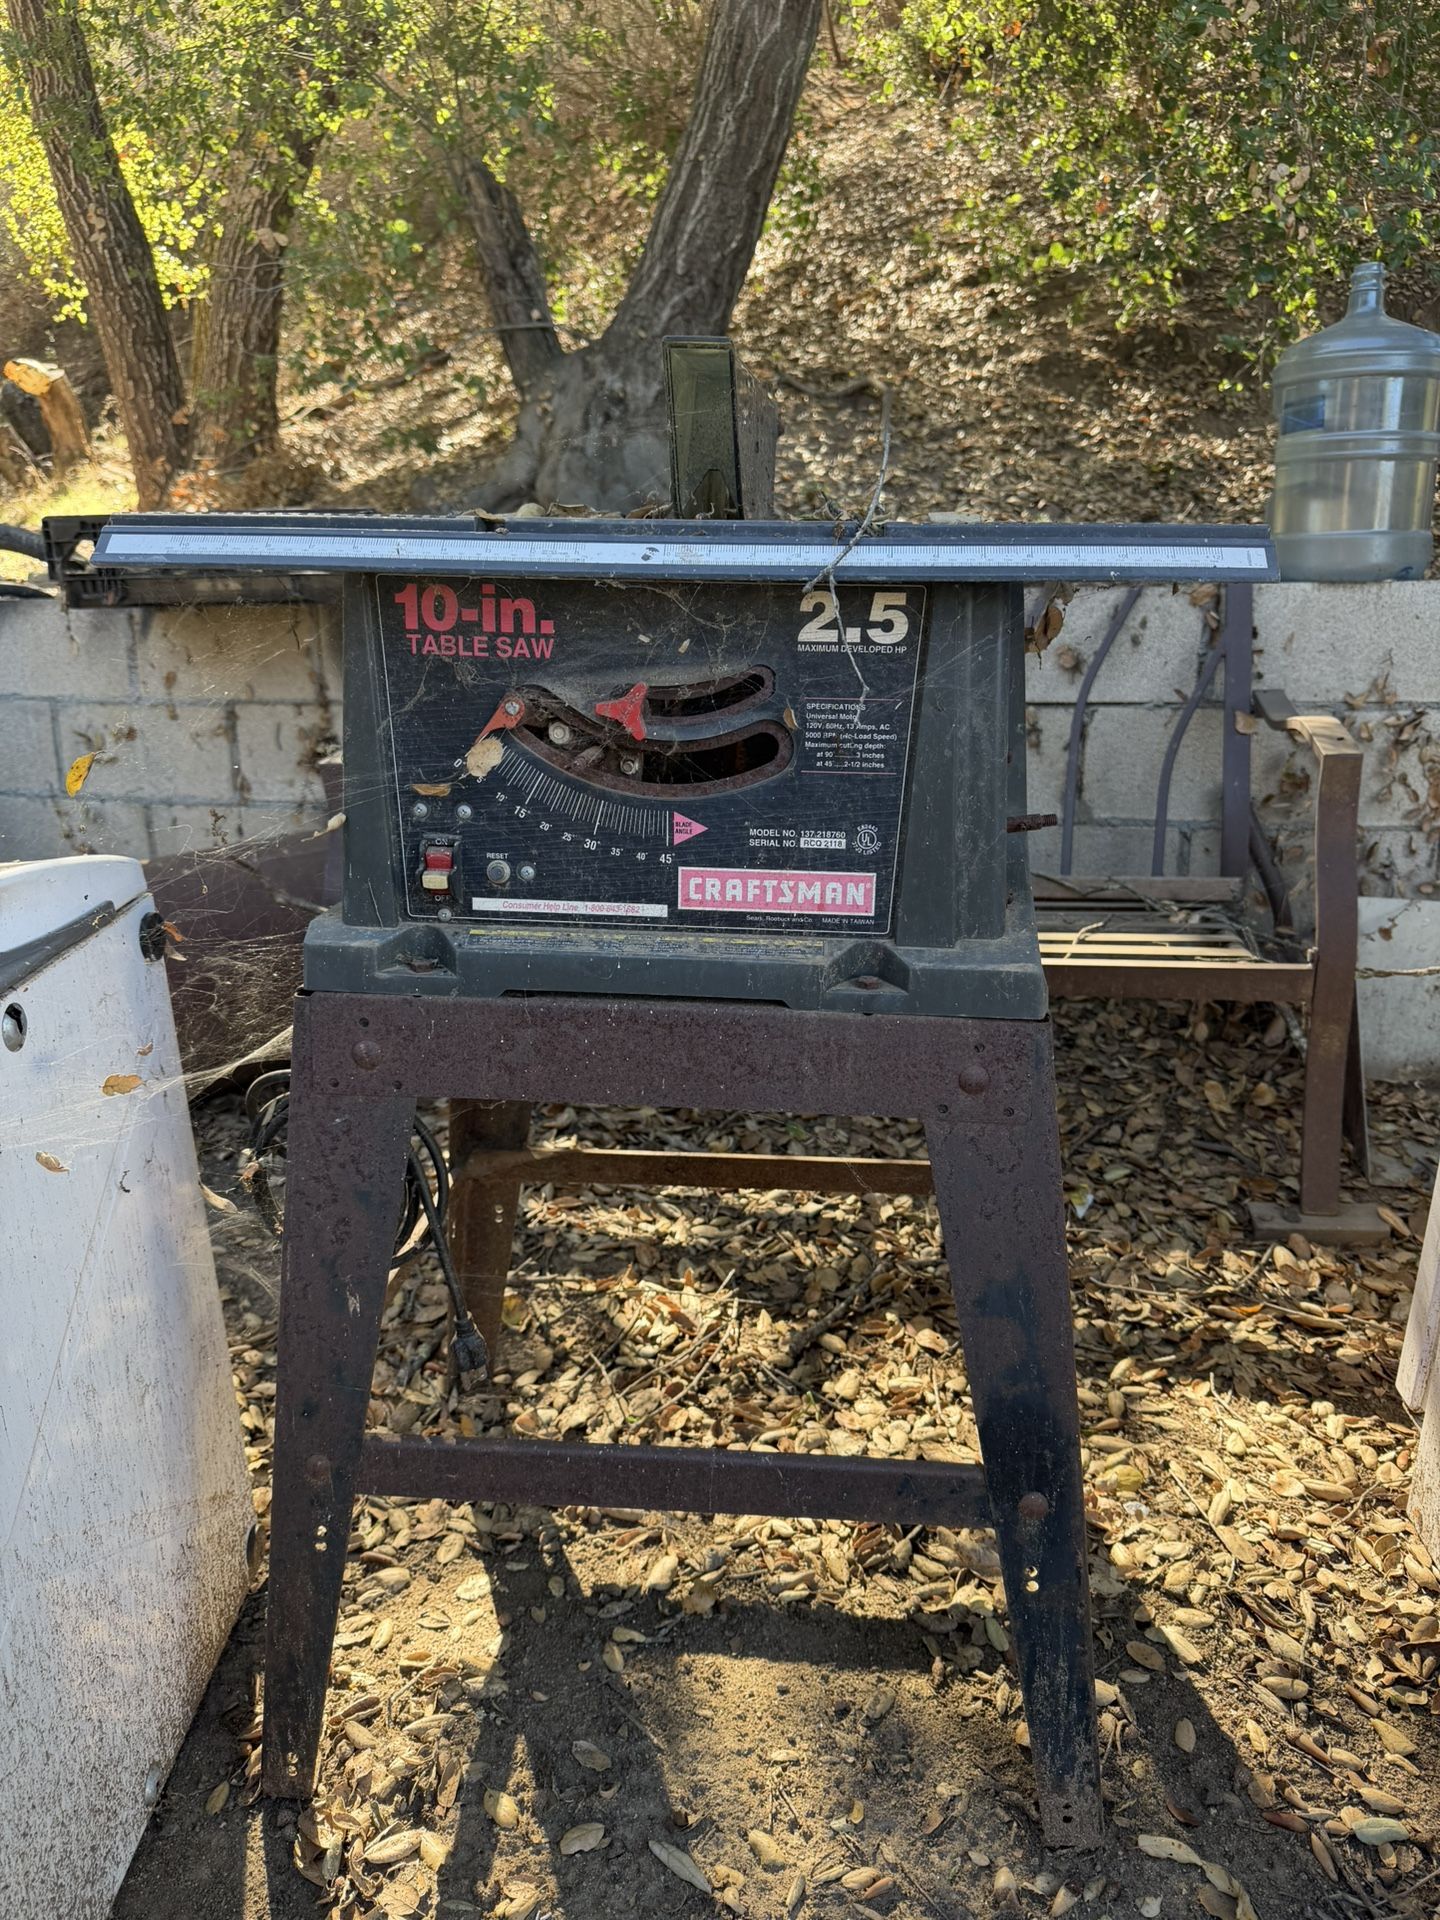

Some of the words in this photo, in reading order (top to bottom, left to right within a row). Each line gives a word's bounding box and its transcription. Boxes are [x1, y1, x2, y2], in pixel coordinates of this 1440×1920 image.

[394, 583, 555, 634] 10-in.
[797, 590, 909, 644] 2.5
[405, 634, 489, 657] TABLE
[496, 636, 555, 659] SAW
[797, 644, 839, 652] MAXIMUM
[840, 645, 894, 653] DEVELOPED
[894, 645, 908, 654] HP
[805, 712, 839, 720] Universal
[839, 712, 858, 720] Moto
[879, 723, 891, 731] AC
[805, 731, 822, 739] 5000
[872, 733, 898, 741] Speed)
[749, 828, 781, 837] MODEL
[782, 829, 798, 838] NO.
[435, 838, 448, 846] ON
[749, 838, 781, 847] SERIAL
[782, 839, 798, 848] NO.
[502, 900, 542, 910] Consumer
[543, 901, 561, 912] Help
[562, 902, 579, 911] Line
